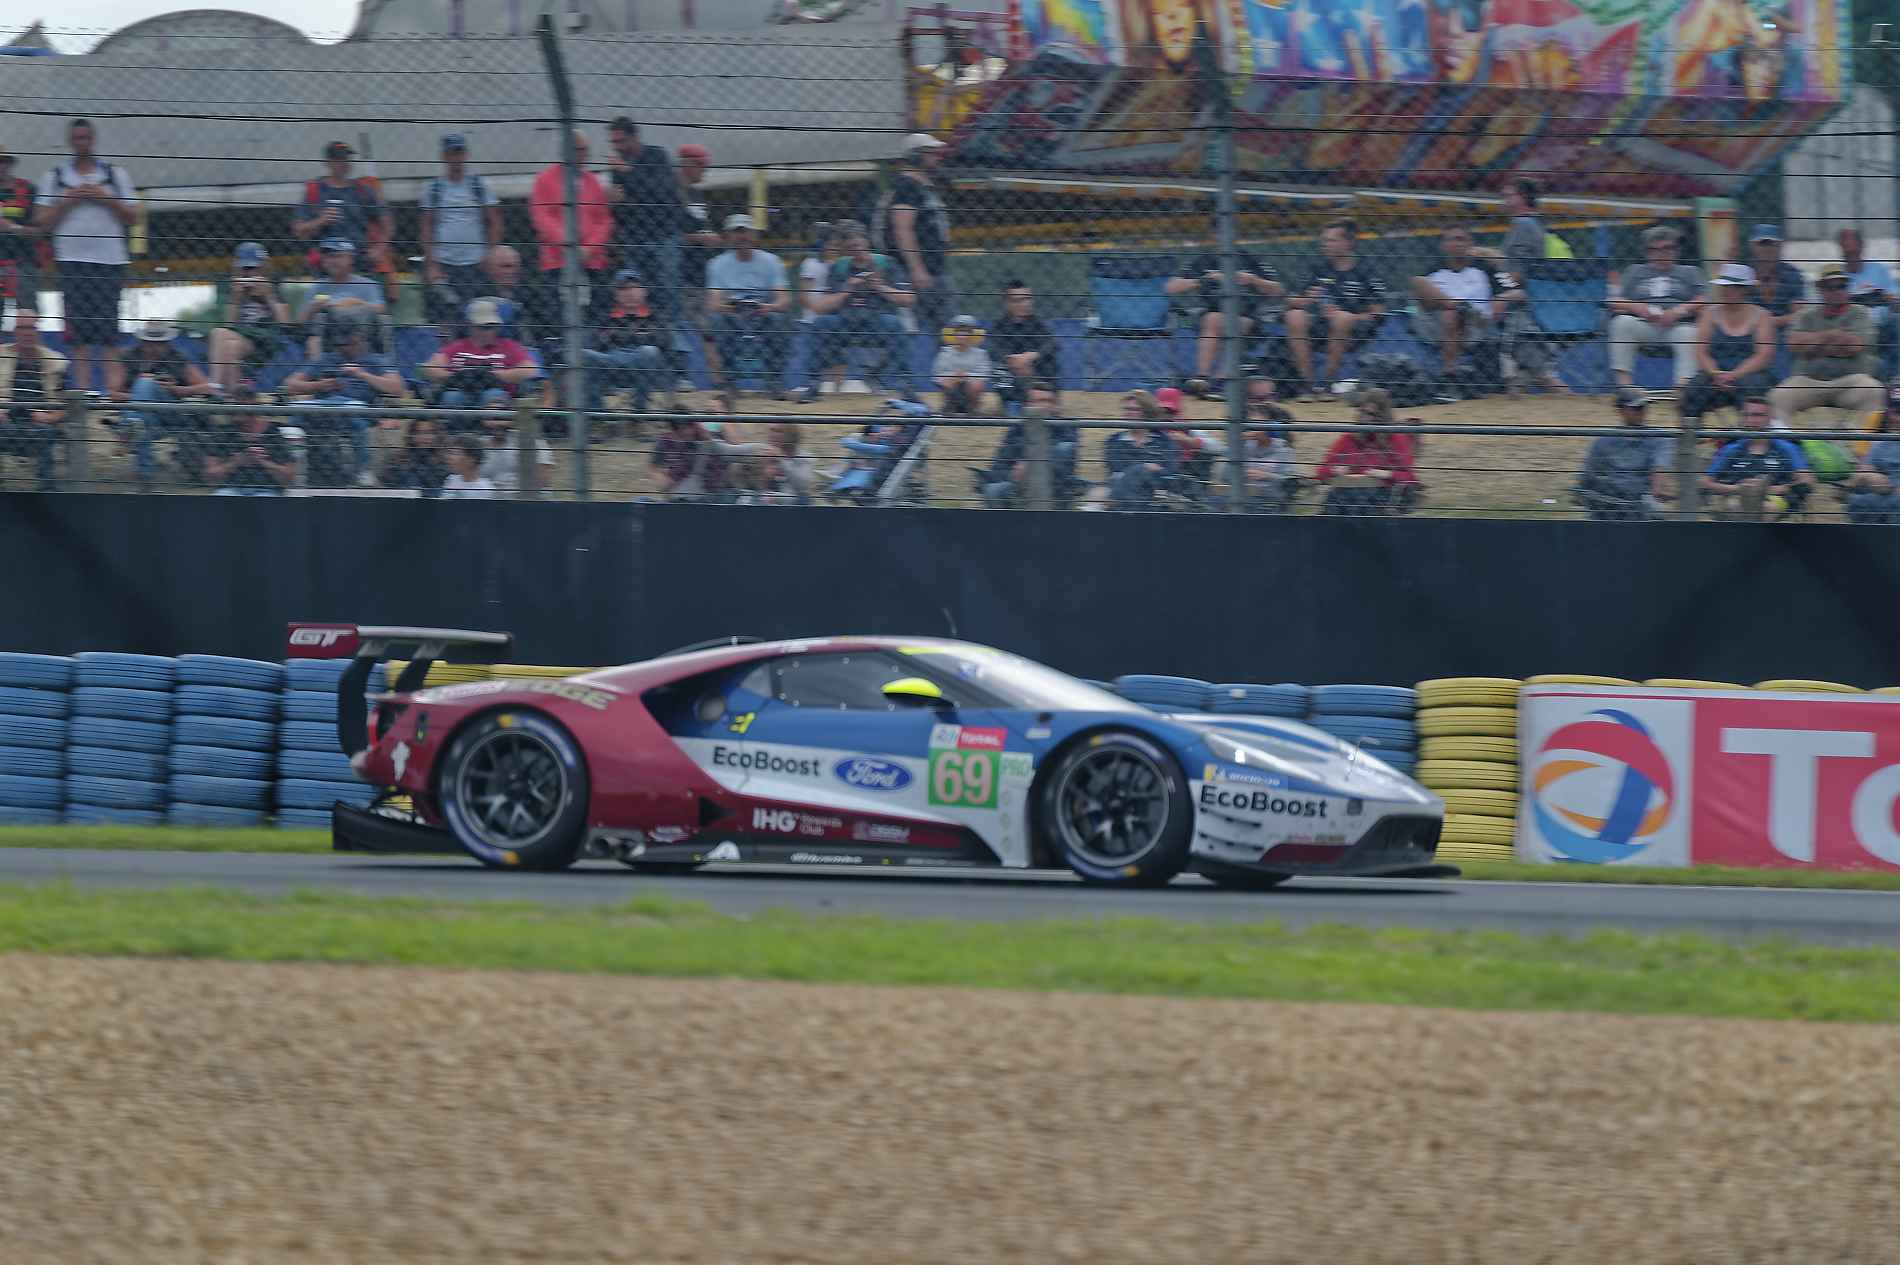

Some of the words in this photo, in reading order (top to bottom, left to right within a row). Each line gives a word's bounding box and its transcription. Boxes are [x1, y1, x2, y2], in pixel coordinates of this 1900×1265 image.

[289, 627, 353, 648] GT
[713, 746, 820, 777] EcoBoost
[844, 758, 897, 788] Ford
[935, 751, 992, 804] 69
[1200, 785, 1328, 818] EcoBoost
[752, 807, 796, 832] IHG
